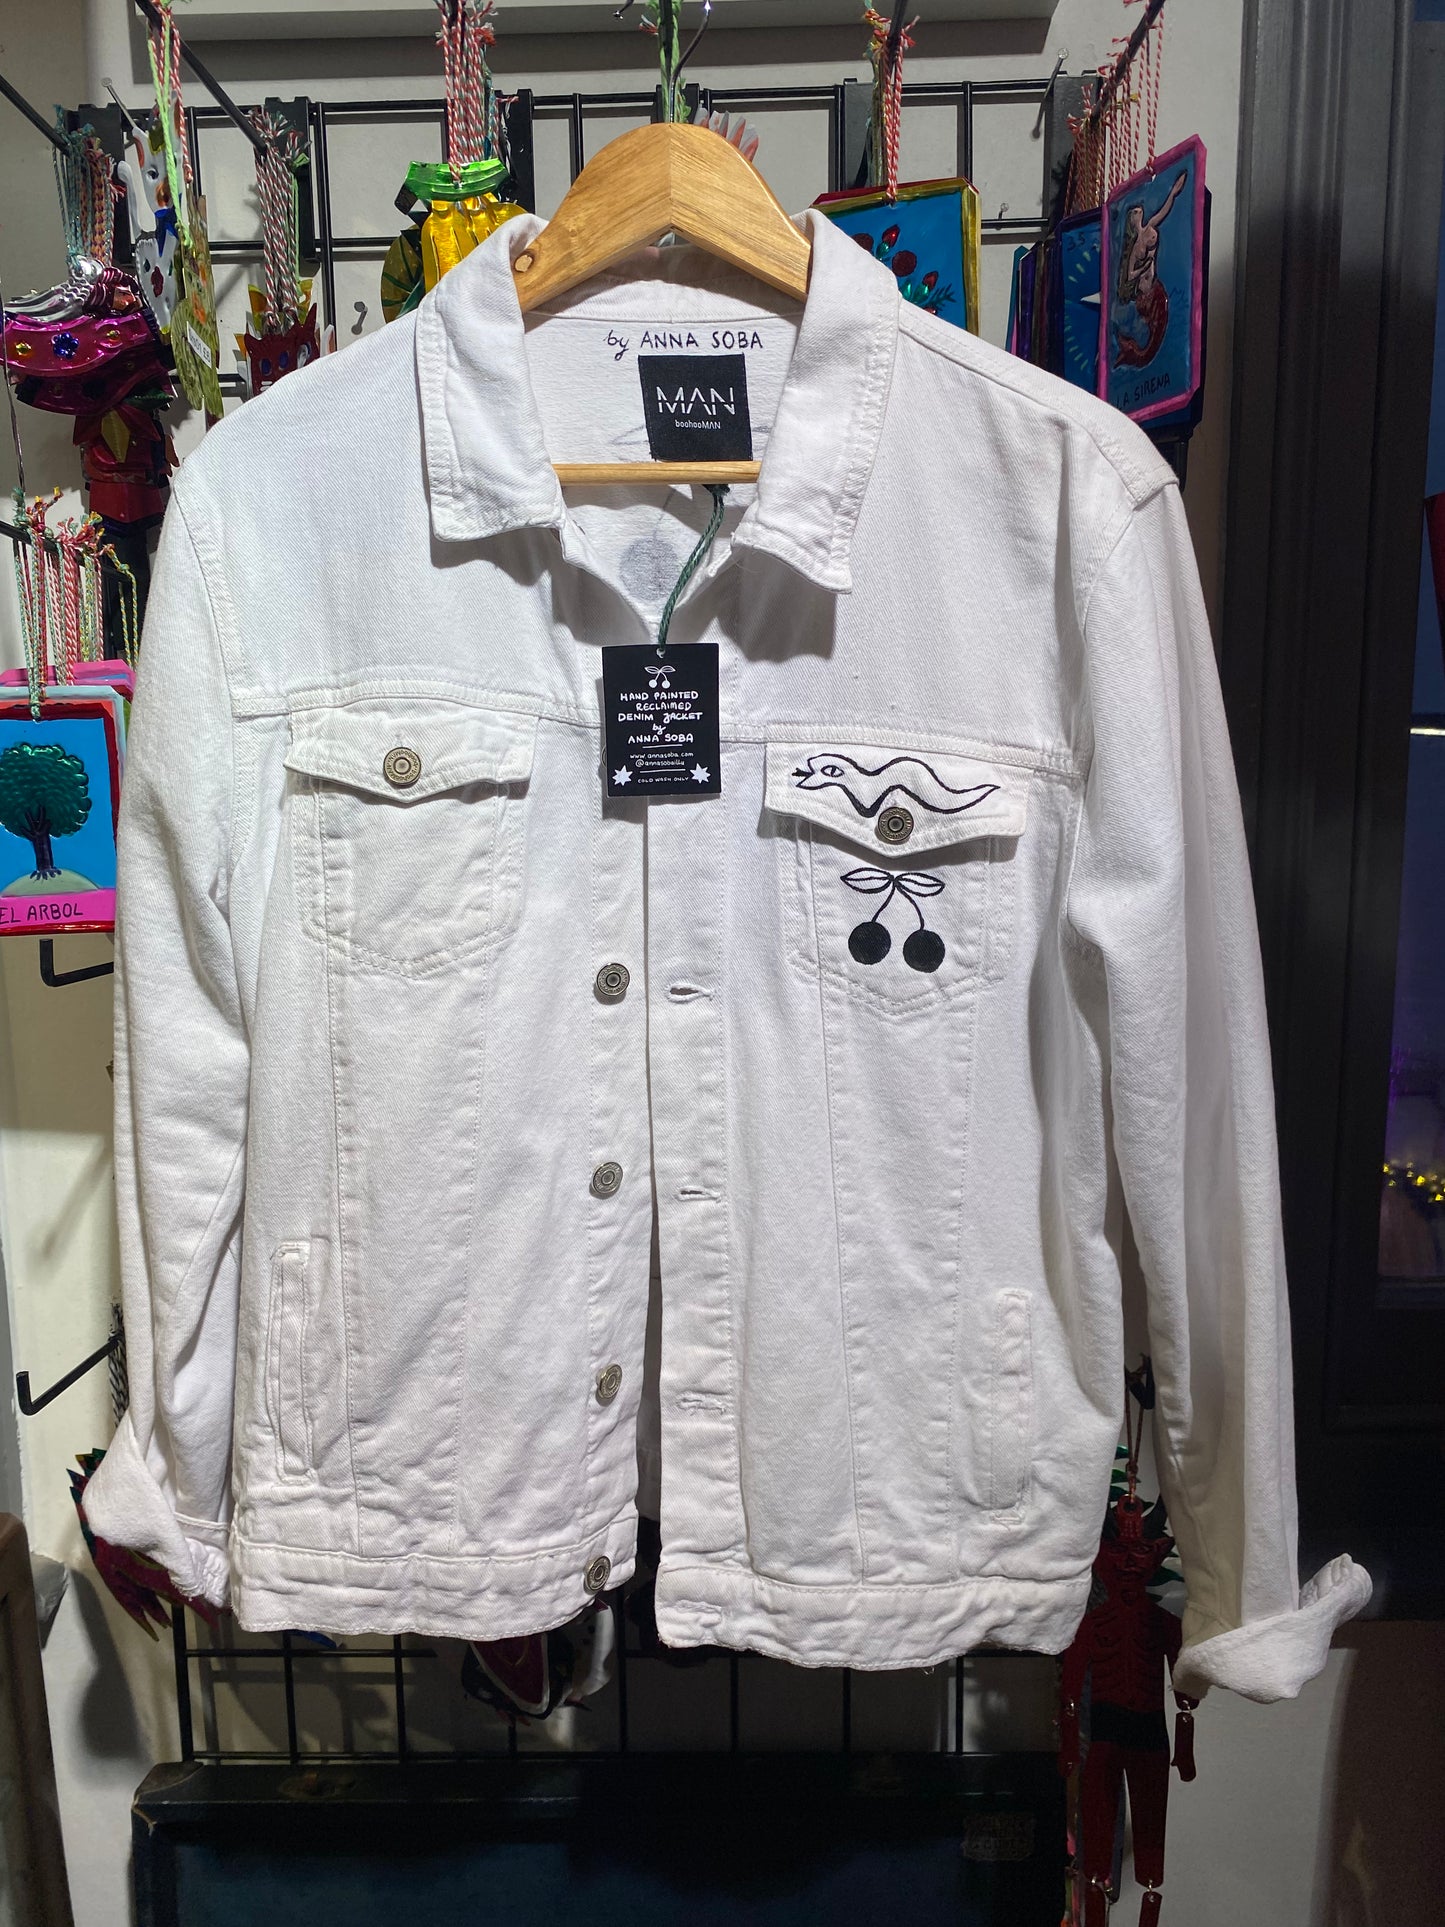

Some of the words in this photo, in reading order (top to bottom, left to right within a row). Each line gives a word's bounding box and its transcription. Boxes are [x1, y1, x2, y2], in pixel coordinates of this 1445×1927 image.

[603, 329, 630, 361] by
[640, 330, 699, 349] ANNA
[711, 330, 763, 349] SOBA
[1116, 391, 1129, 410] LA
[1134, 372, 1172, 401] SIRENA
[656, 386, 736, 416] MAN
[674, 419, 721, 429] boohooMAN
[620, 692, 649, 701] HAND
[653, 690, 699, 700] PAINTED
[635, 701, 692, 711] RECLAIMED
[618, 712, 654, 722] DENIM
[663, 711, 703, 724] JACKET
[652, 723, 667, 735] by
[628, 734, 660, 744] ANNA
[664, 733, 694, 743] SOBA
[0, 907, 21, 924] EL
[27, 903, 84, 921] ARBOL
